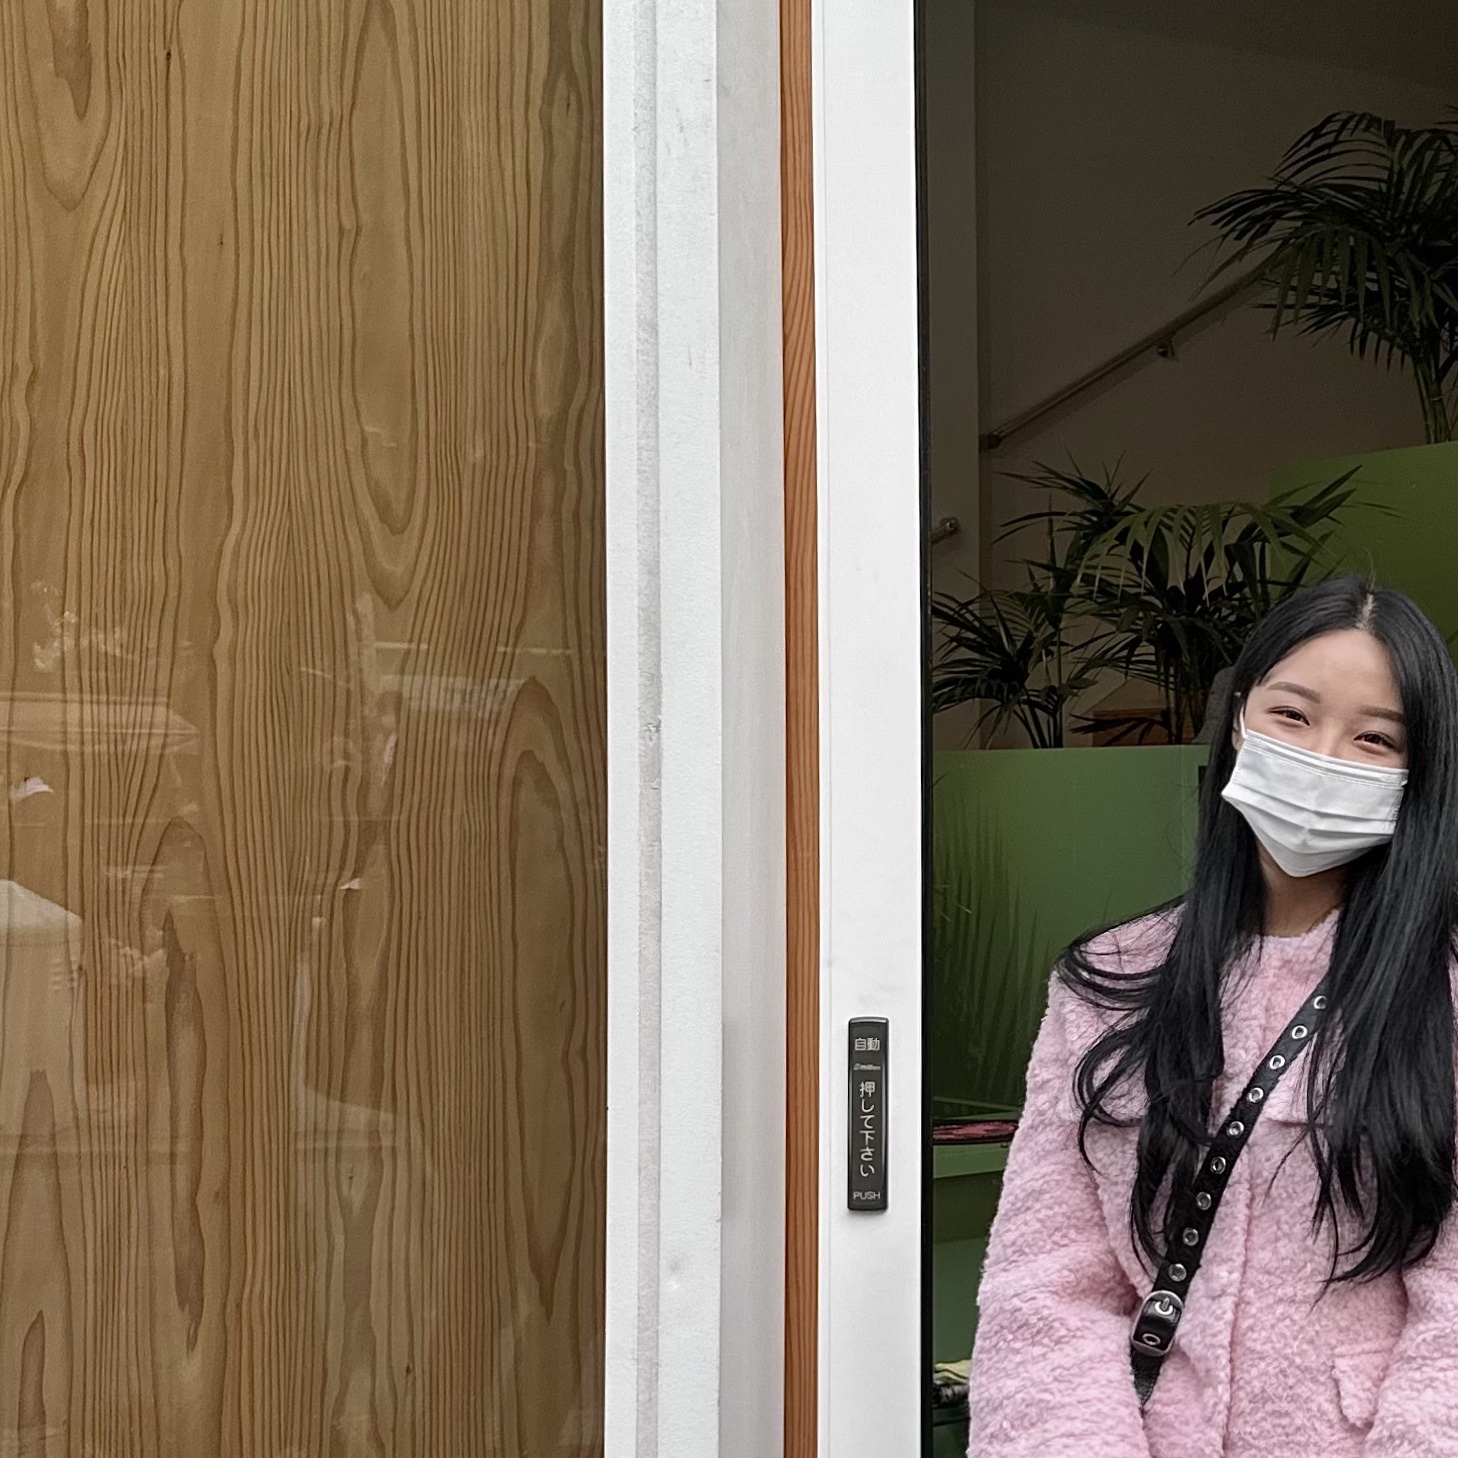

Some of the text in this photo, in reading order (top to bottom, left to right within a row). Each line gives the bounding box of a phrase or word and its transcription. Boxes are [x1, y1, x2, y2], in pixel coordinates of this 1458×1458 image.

[854, 1037, 881, 1051] 自動
[859, 1081, 876, 1177] 押して下さい
[853, 1191, 881, 1200] PUSH
